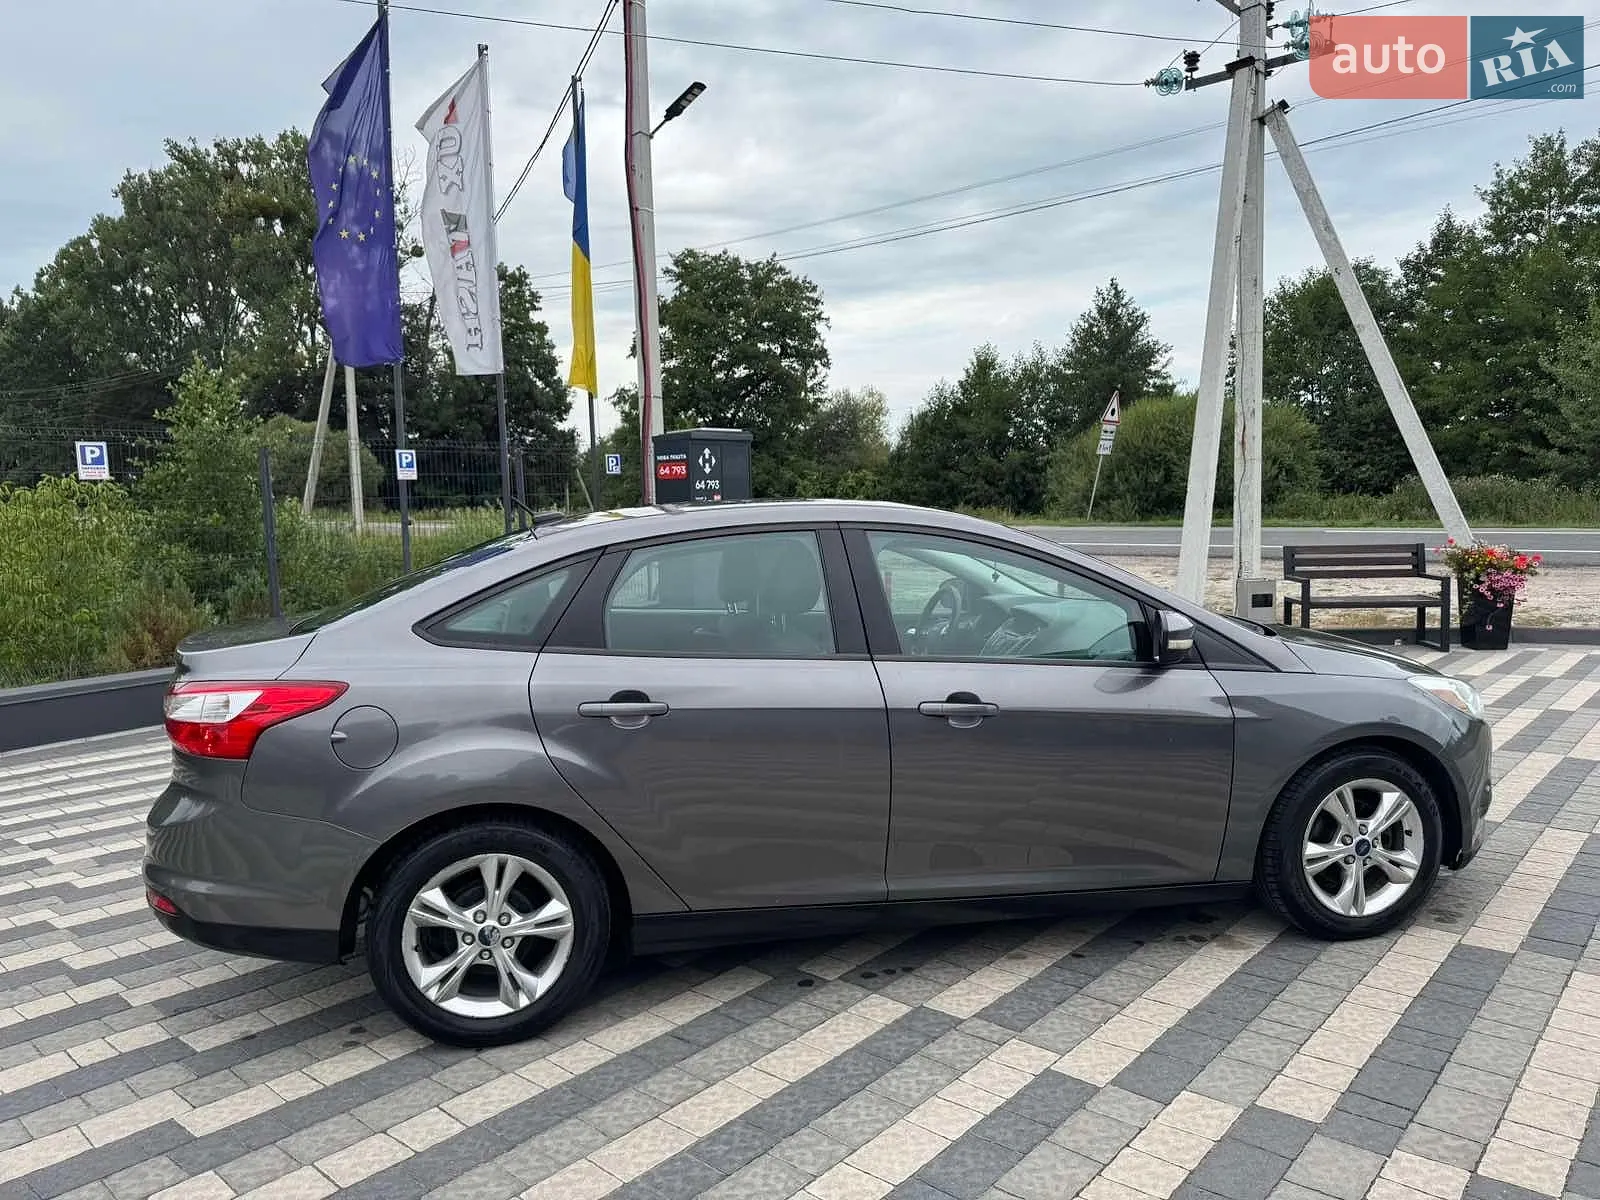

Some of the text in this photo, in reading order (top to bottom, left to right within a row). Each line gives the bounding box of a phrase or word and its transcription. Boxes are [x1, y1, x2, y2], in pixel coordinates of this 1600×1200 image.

[85, 446, 100, 465] P
[402, 453, 412, 468] P
[608, 457, 617, 471] P
[659, 465, 687, 475] 64 793
[695, 479, 720, 490] 64 793
